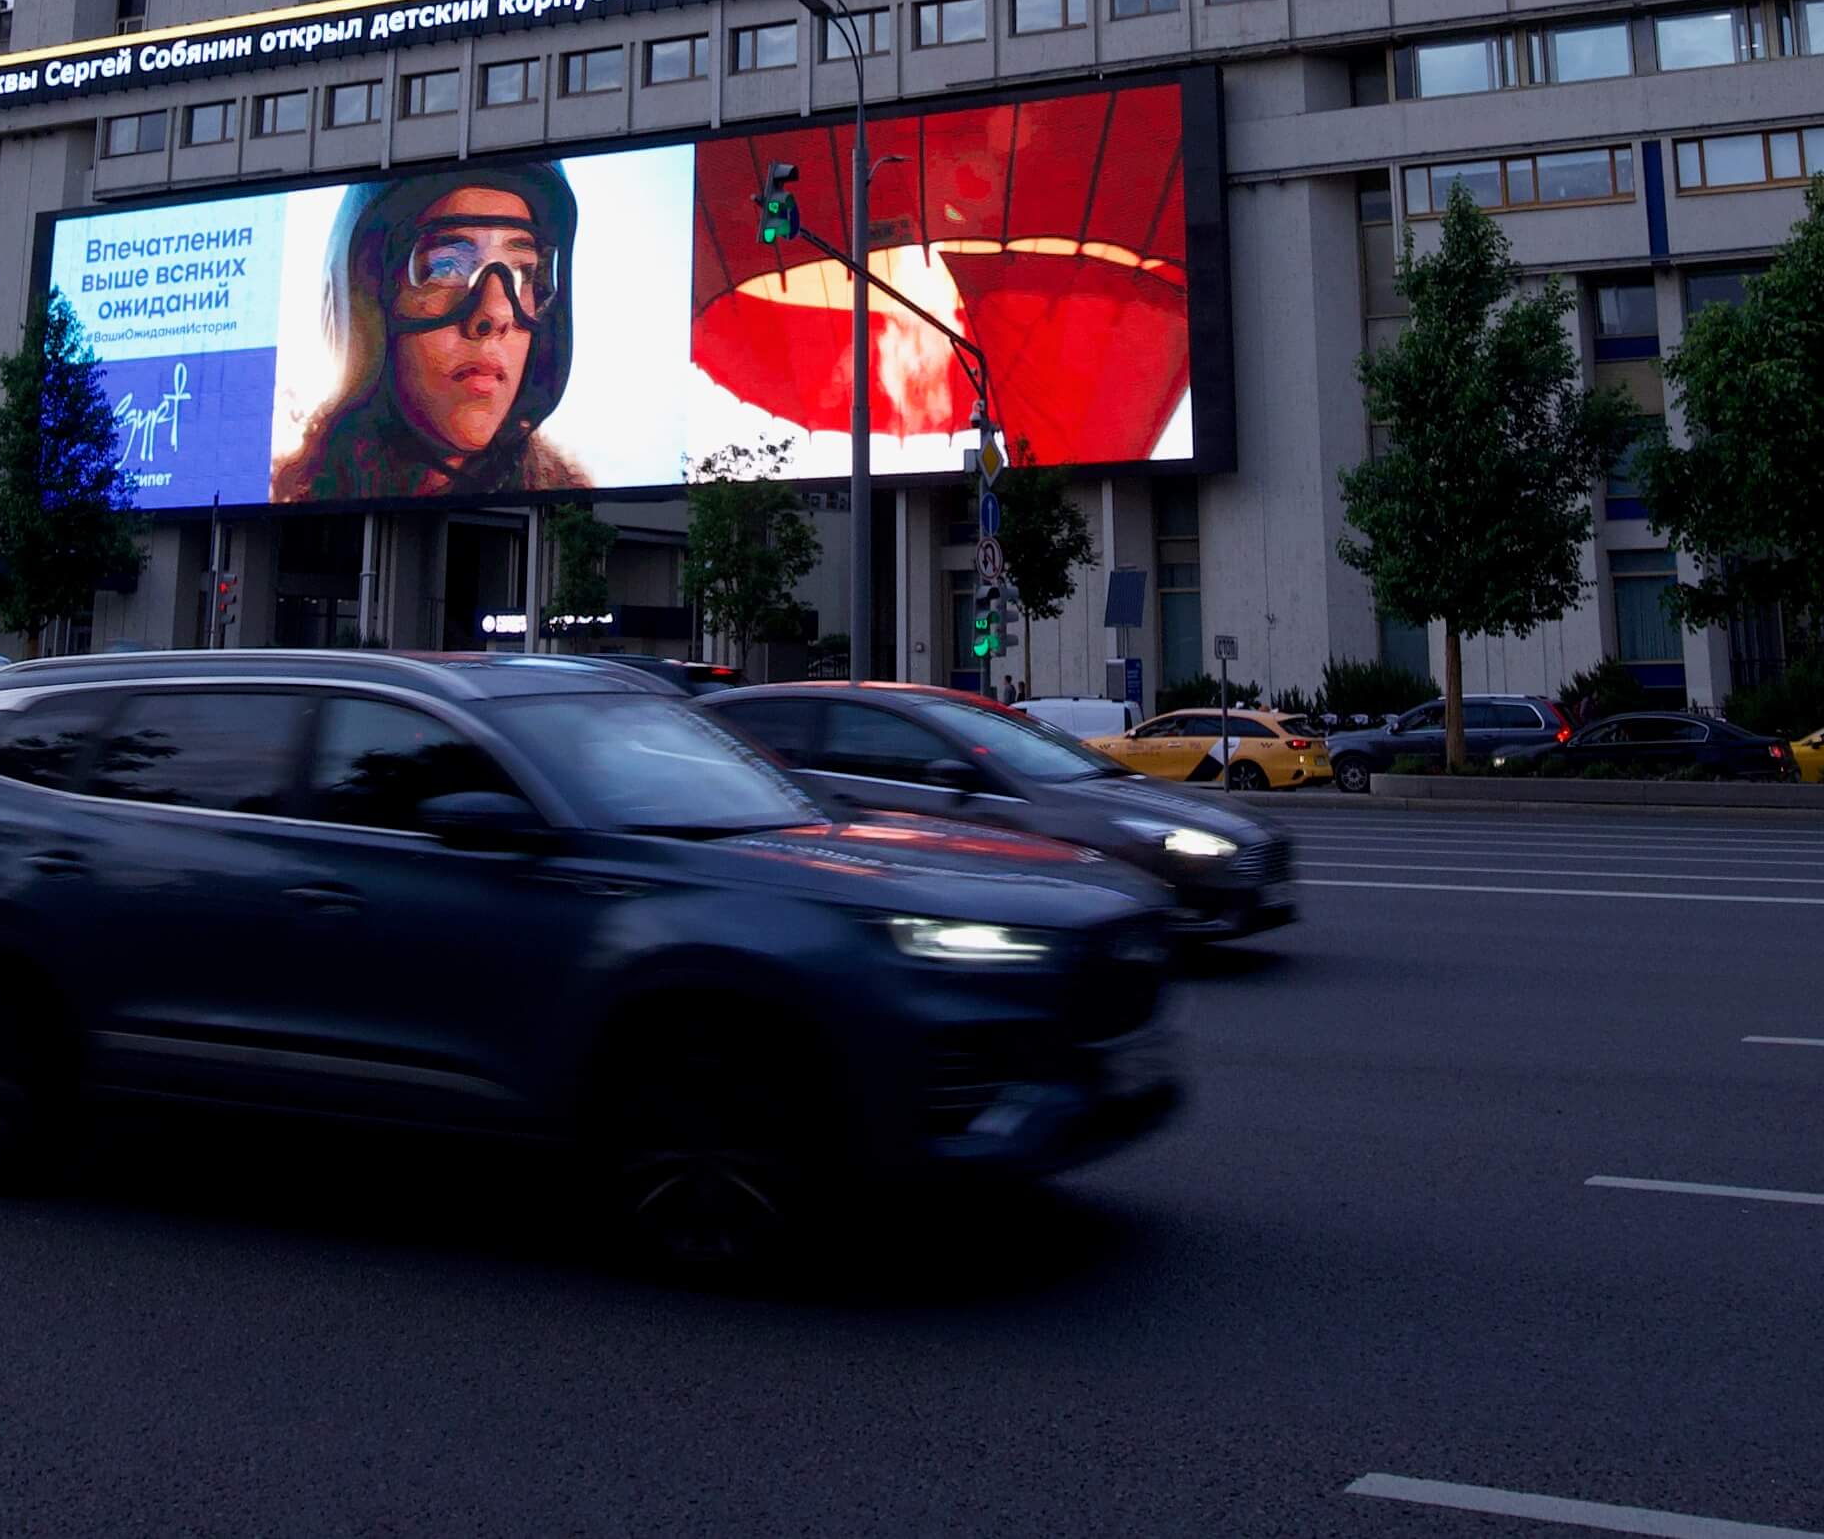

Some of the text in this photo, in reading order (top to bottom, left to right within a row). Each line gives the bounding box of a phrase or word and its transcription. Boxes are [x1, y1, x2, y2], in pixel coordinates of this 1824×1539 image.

[44, 48, 132, 89] Сергей
[139, 35, 252, 73] Собянин
[260, 16, 362, 53] открыл
[85, 227, 253, 263] Впечатления
[81, 257, 247, 293] выше всяких
[98, 282, 230, 320] ожиданий
